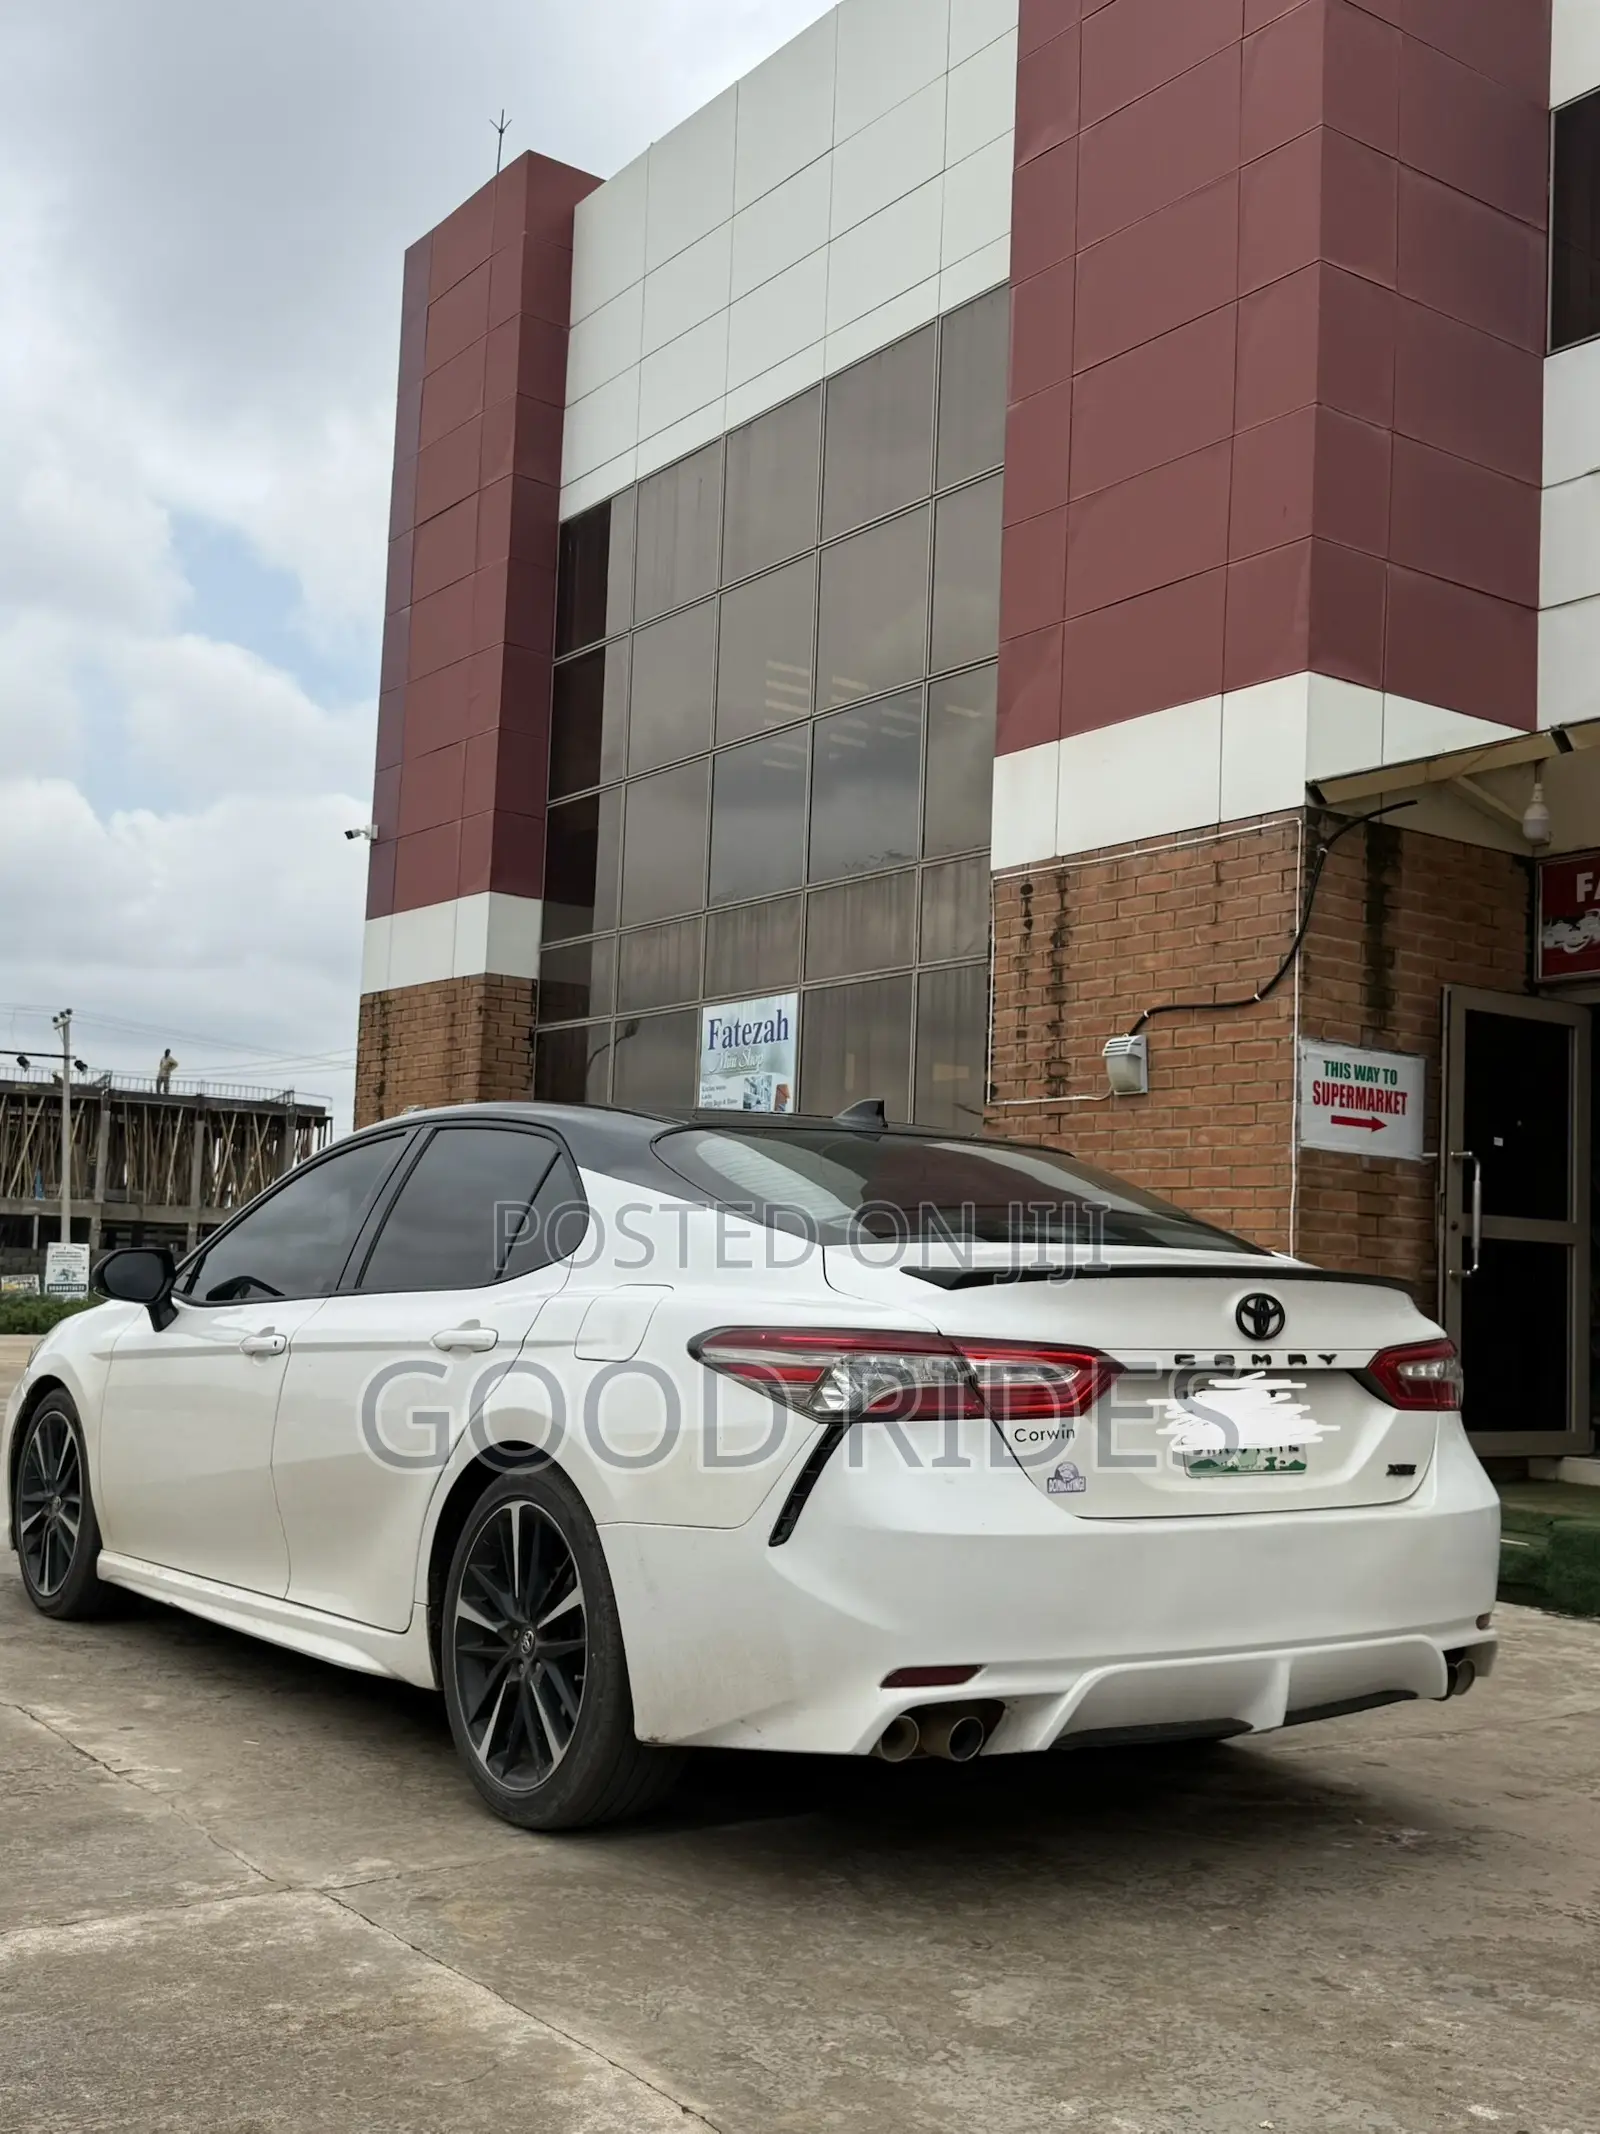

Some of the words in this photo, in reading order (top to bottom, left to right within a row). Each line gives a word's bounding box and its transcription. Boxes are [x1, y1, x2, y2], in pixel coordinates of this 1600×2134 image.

[707, 1008, 789, 1051] Fatezah
[738, 1046, 765, 1074] Shop
[1323, 1059, 1352, 1080] THIS
[1353, 1063, 1381, 1084] WAY
[1382, 1067, 1399, 1086] TO
[1311, 1079, 1409, 1116] SUPERMARKET
[1173, 1353, 1338, 1366] CAMRY
[1014, 1423, 1076, 1443] Corwin
